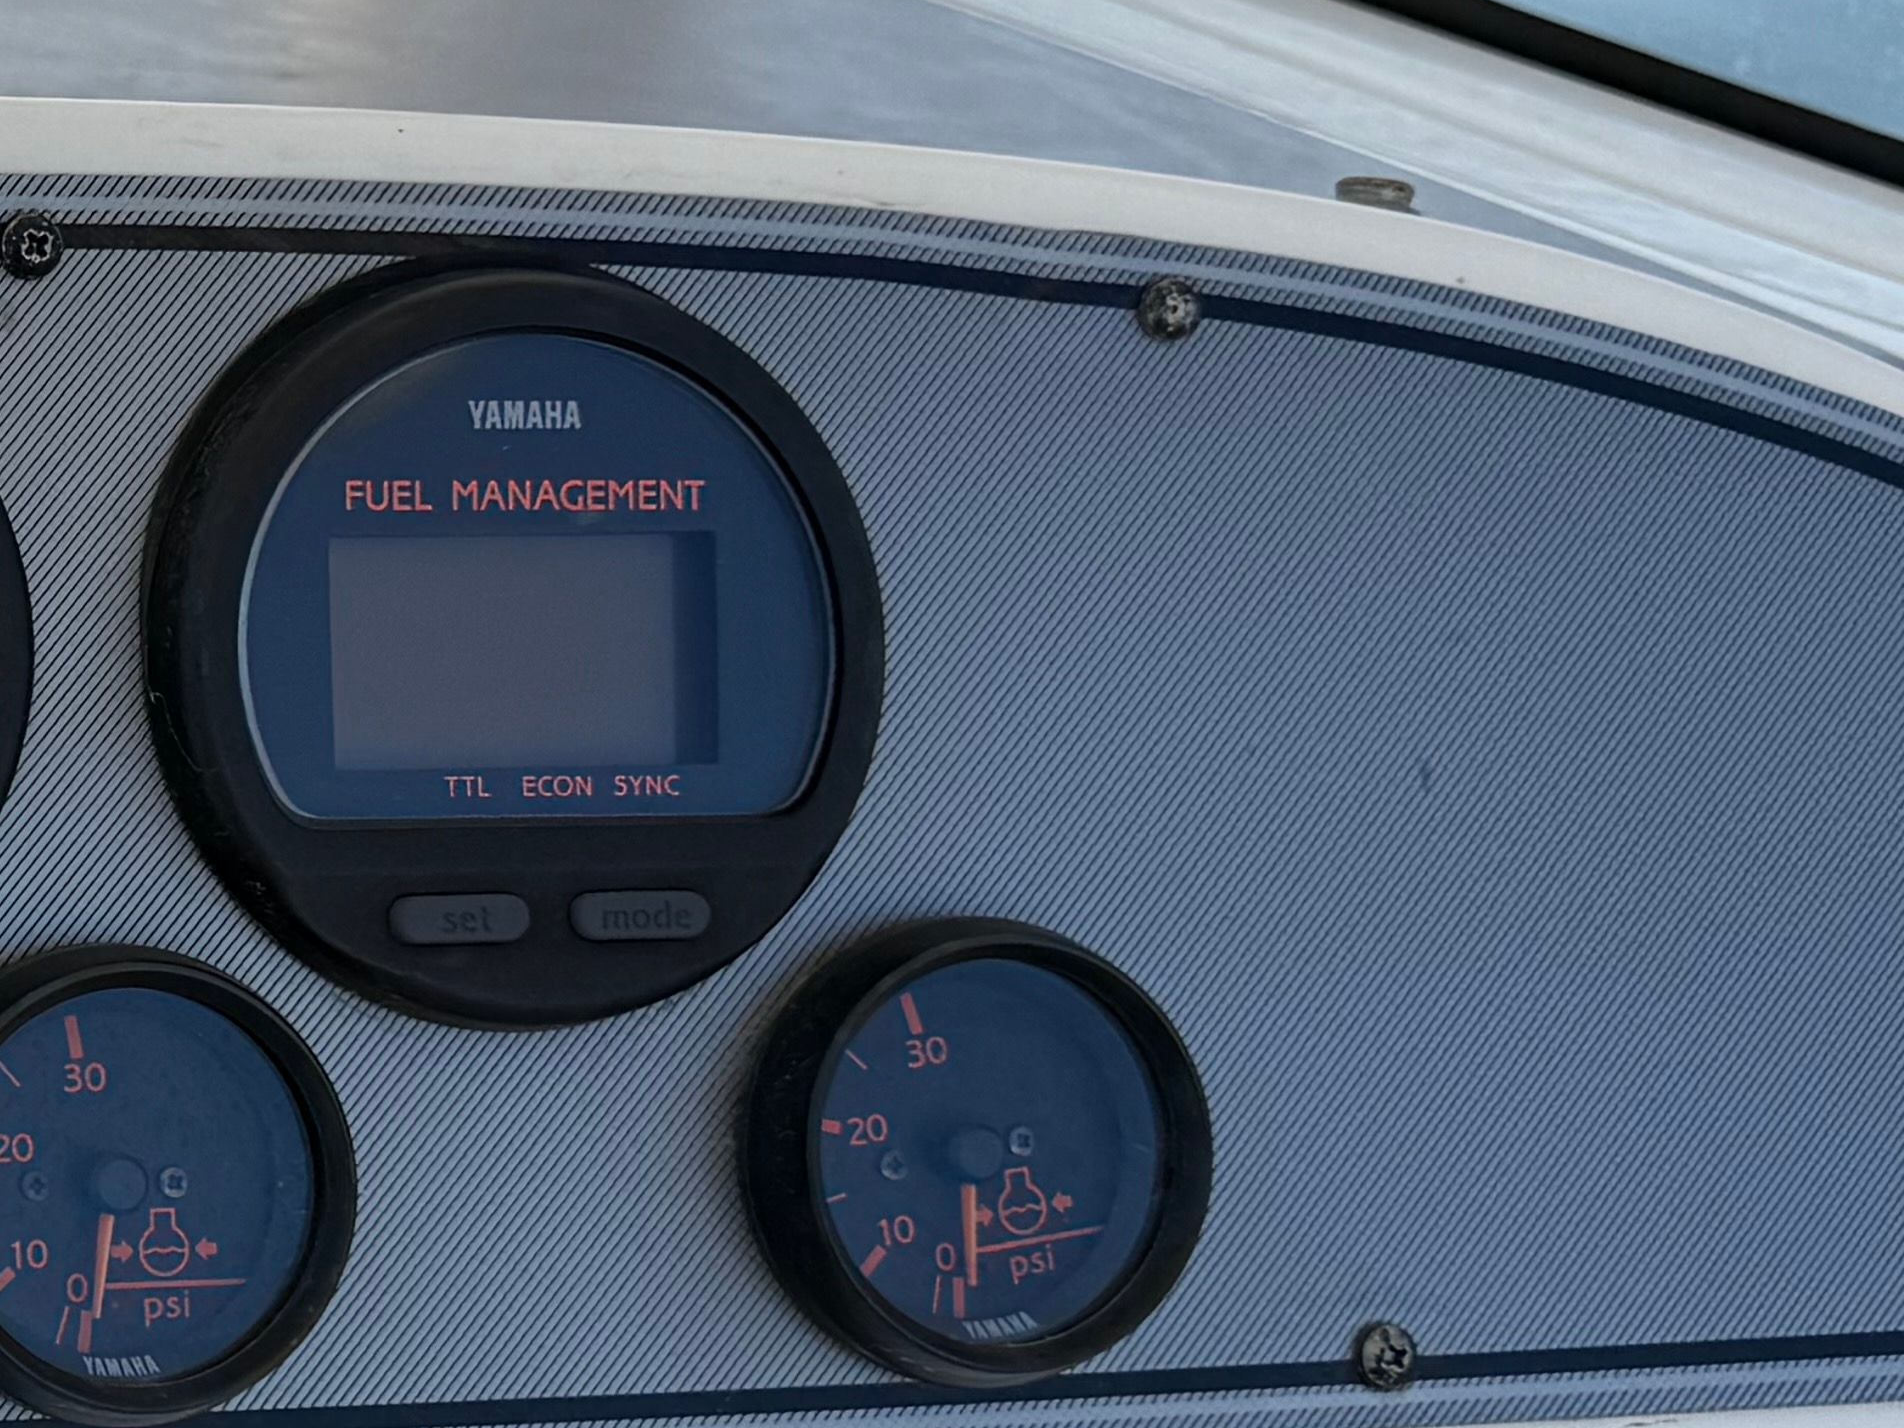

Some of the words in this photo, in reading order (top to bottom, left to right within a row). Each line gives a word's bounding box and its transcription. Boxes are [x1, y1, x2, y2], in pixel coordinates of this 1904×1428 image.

[468, 400, 582, 430] YAMAHA
[345, 479, 432, 512] FUEL
[451, 479, 705, 512] MANAGEMENT
[444, 776, 491, 798] TTL
[522, 776, 592, 797] ECON
[613, 775, 680, 797] SYNC
[442, 906, 494, 933] set
[601, 900, 693, 931] mode
[905, 1036, 948, 1069] 30
[63, 1062, 108, 1093] 30
[847, 1113, 888, 1146] 20
[878, 1215, 915, 1246] 10
[10, 1239, 48, 1269] 10
[935, 1243, 957, 1271] 0
[1009, 1244, 1056, 1285] psi
[66, 1273, 89, 1303] 0
[144, 1290, 190, 1327] psi
[962, 1310, 1038, 1340] YAMAHA
[82, 1354, 161, 1377] YAMAHA
